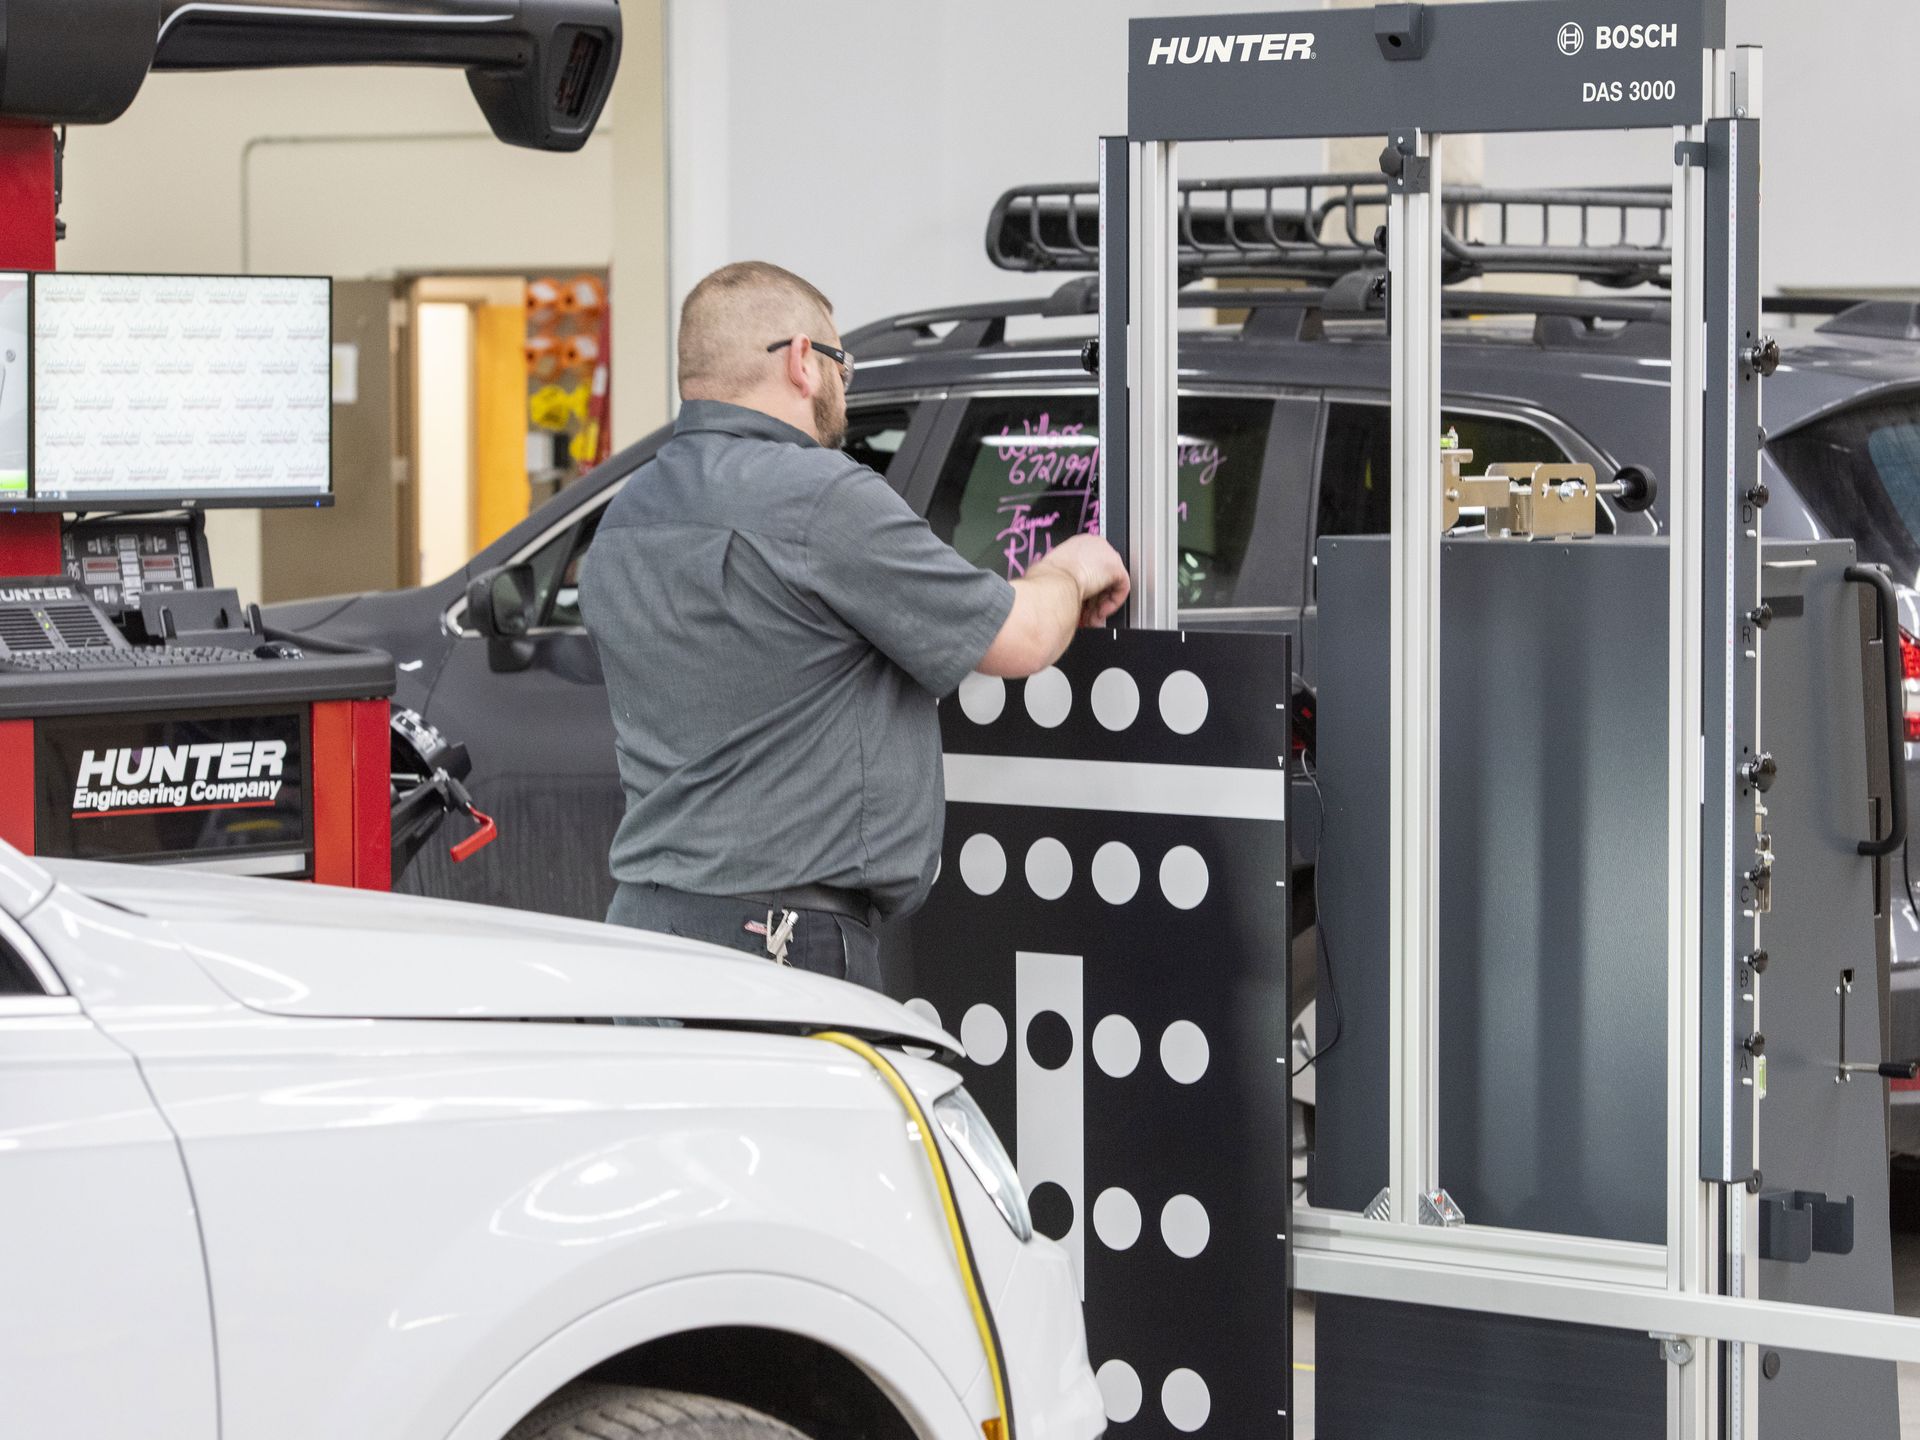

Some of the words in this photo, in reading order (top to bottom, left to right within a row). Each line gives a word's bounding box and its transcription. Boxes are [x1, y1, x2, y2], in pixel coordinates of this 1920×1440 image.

[1148, 33, 1315, 66] HUNTER
[1595, 23, 1678, 50] BOSCH
[1582, 82, 1623, 103] DAS
[1628, 80, 1676, 102] 3000
[0, 587, 73, 602] UNTER
[77, 740, 287, 788] HUNTER
[73, 782, 187, 812] Engineering
[190, 779, 282, 807] Company
